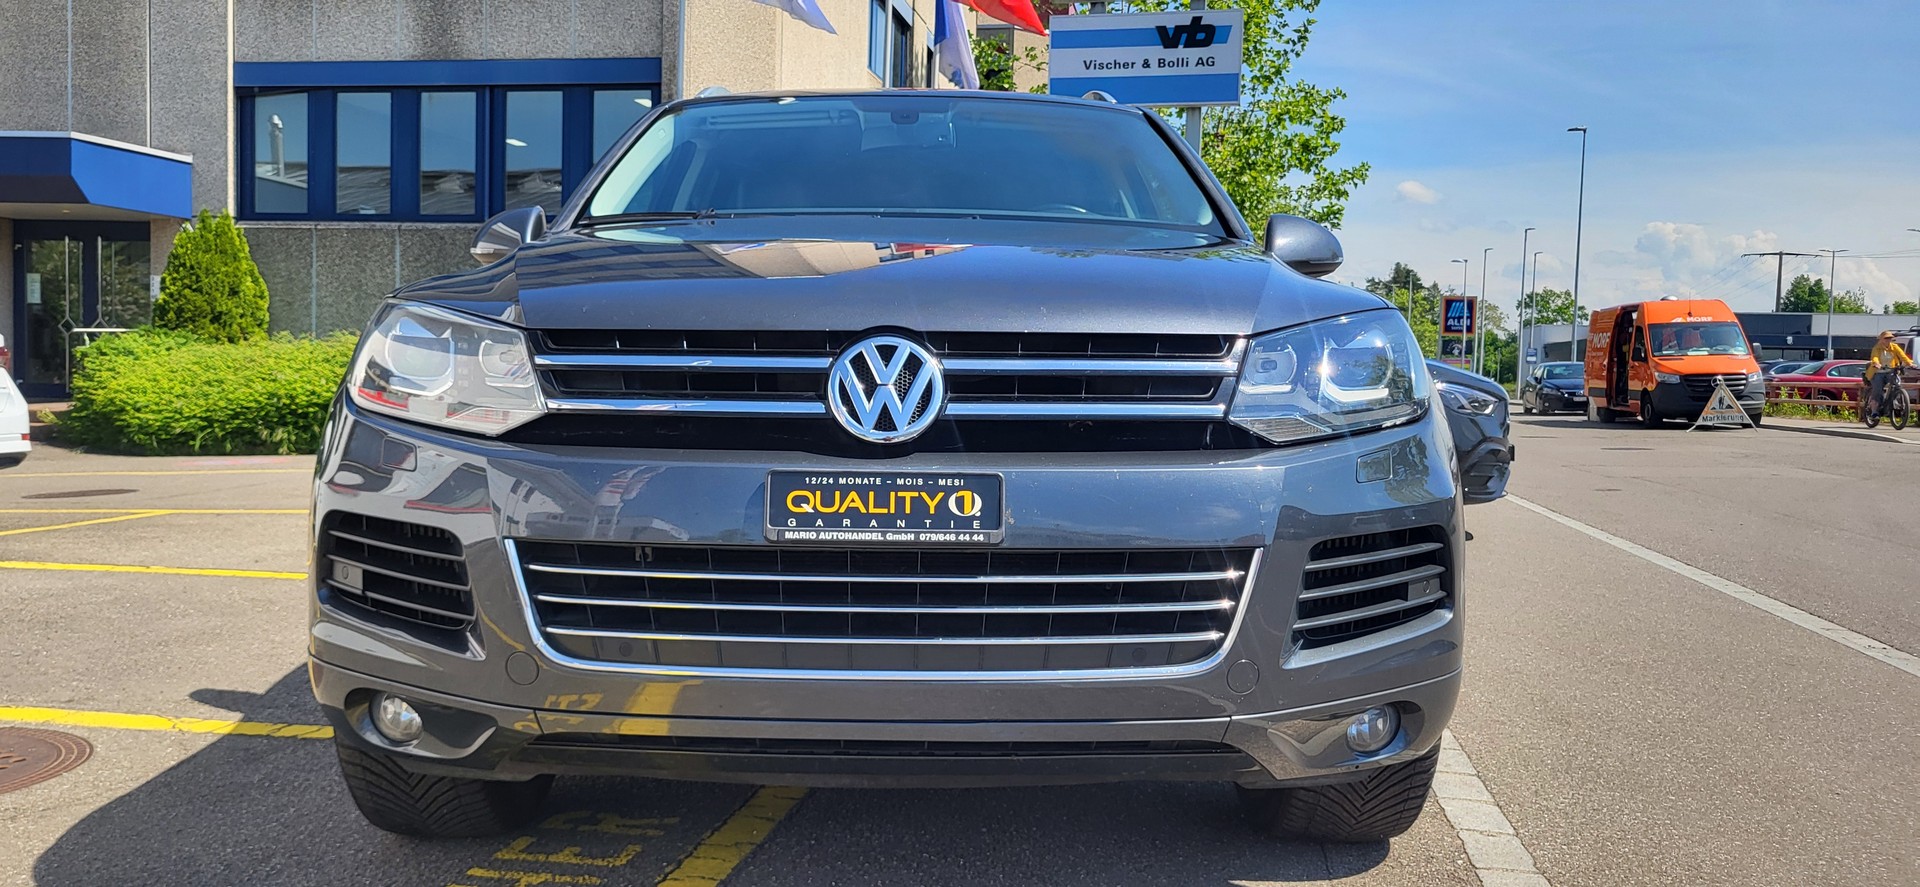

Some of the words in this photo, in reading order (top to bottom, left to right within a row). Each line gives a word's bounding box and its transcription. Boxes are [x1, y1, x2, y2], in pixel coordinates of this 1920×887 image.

[1083, 59, 1136, 71] Vischer
[1142, 59, 1151, 69] &
[1157, 58, 1189, 69] Bolli
[1195, 56, 1216, 68] AG
[1447, 318, 1470, 326] ALDI
[1702, 414, 1744, 422] Markierung
[805, 477, 834, 485] 12/24
[838, 477, 882, 485] MONATE
[896, 478, 924, 486] MOIS
[938, 478, 965, 486] MESI
[786, 490, 945, 514] QUALITY
[787, 518, 981, 529] GARANTIE
[784, 531, 817, 540] MARIO
[819, 531, 884, 541] AUTOHANDEL
[886, 532, 915, 541] GmbH
[919, 533, 956, 542] 079/646
[958, 533, 970, 542] 44
[972, 533, 984, 542] 44
